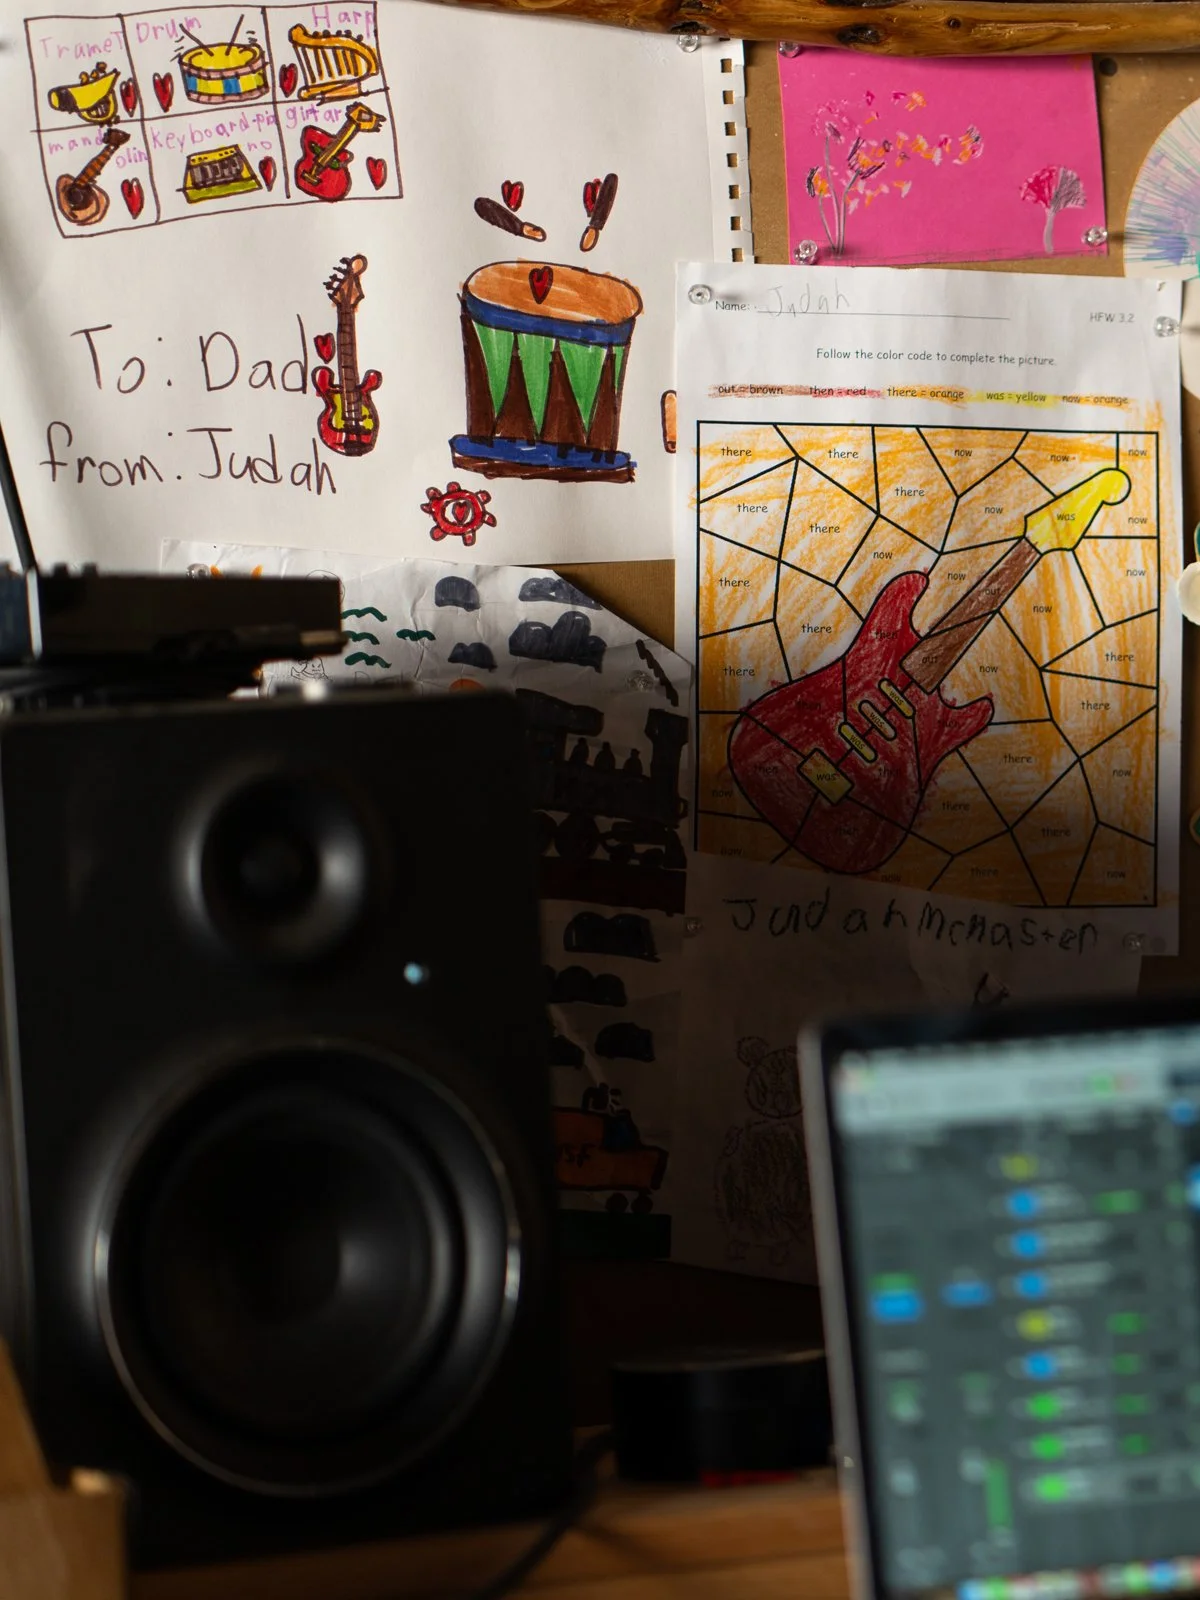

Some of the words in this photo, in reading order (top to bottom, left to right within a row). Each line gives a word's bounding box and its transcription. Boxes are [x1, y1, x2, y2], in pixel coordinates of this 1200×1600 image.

[312, 5, 375, 39] Harp
[136, 15, 202, 44] Drum
[48, 129, 104, 155] mand
[247, 140, 273, 153] no
[768, 278, 850, 317] Judah
[715, 300, 750, 312] Name:
[1089, 312, 1115, 323] HFW
[1119, 312, 1135, 323] 3.2
[71, 323, 173, 395] To:
[200, 314, 311, 395] Dad
[816, 348, 850, 359] Follow
[855, 349, 873, 360] the
[876, 350, 904, 360] color
[907, 350, 933, 361] code
[936, 352, 947, 361] to
[950, 352, 995, 365] complete
[999, 354, 1016, 364] the
[1018, 355, 1057, 366] picture.
[717, 386, 736, 394] out
[749, 385, 784, 395] brown
[809, 386, 834, 395] then
[846, 386, 867, 395] red
[887, 387, 917, 396] there
[929, 389, 964, 399] orange
[986, 392, 1005, 400] was
[1015, 391, 1047, 403] yellow
[1093, 395, 1129, 405] orange
[721, 447, 752, 457] there
[828, 449, 859, 459] there
[954, 449, 973, 457] now
[1128, 448, 1147, 457] now
[40, 421, 183, 486] from:
[187, 426, 337, 495] Judah
[1050, 454, 1070, 462] now
[895, 487, 925, 497] there
[737, 503, 768, 513] there
[1056, 513, 1076, 521] was
[1128, 516, 1148, 524] now
[809, 524, 840, 533] there
[873, 551, 893, 560] now
[947, 572, 966, 581] now
[1126, 568, 1146, 577] now
[719, 577, 750, 587] there
[1033, 605, 1053, 613] now
[801, 624, 832, 633] there
[922, 655, 939, 664] out
[1105, 652, 1135, 662] there
[722, 666, 755, 676] there
[979, 665, 998, 674] now
[889, 690, 904, 706] was
[1081, 701, 1110, 711] there
[869, 712, 884, 728] was
[850, 734, 864, 750] was
[1003, 754, 1032, 763] there
[816, 772, 836, 782] was
[1112, 768, 1132, 777] now
[711, 789, 733, 798] now
[942, 802, 970, 811] there
[1041, 827, 1071, 837] there
[720, 847, 743, 856] now
[970, 867, 999, 877] there
[1106, 871, 1126, 879] now
[722, 886, 907, 937] Judah
